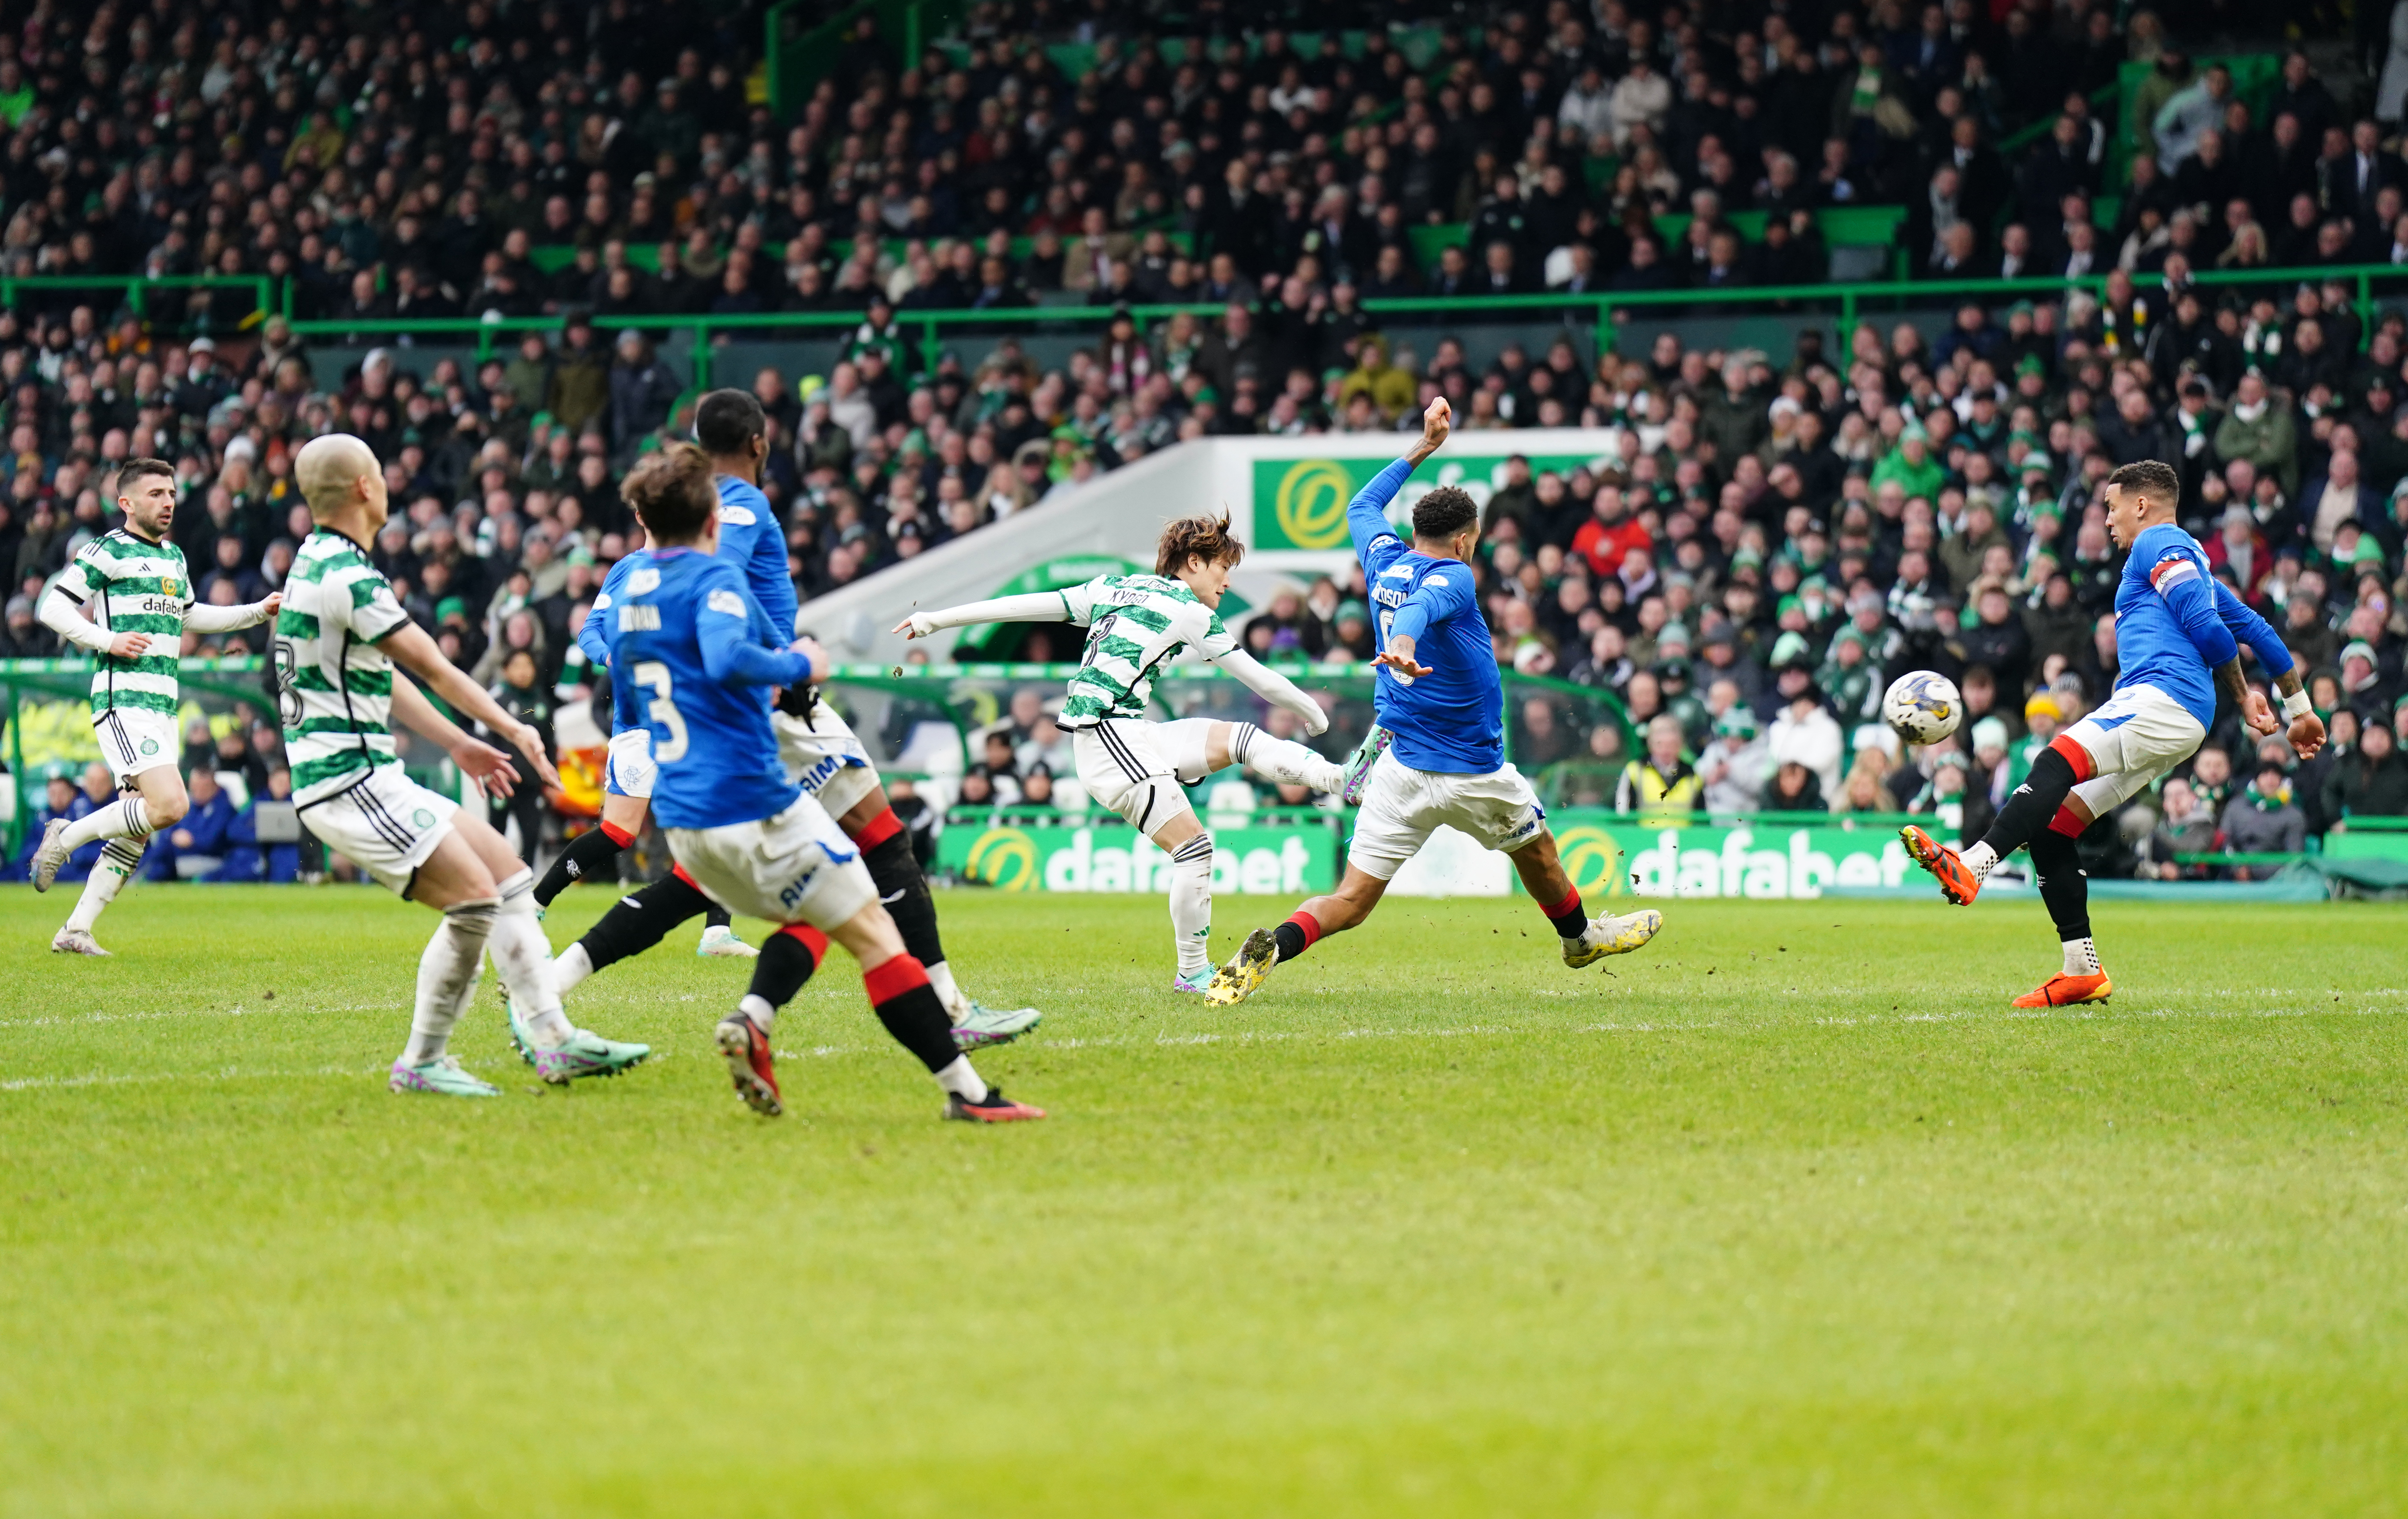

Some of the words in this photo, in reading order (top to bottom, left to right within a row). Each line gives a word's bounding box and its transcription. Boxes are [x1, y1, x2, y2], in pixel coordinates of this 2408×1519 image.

[142, 598, 182, 616] dafabe
[1109, 590, 1150, 604] KYOGO
[633, 660, 689, 762] 3
[800, 755, 841, 793] AIM
[1629, 828, 1910, 899] dafabet
